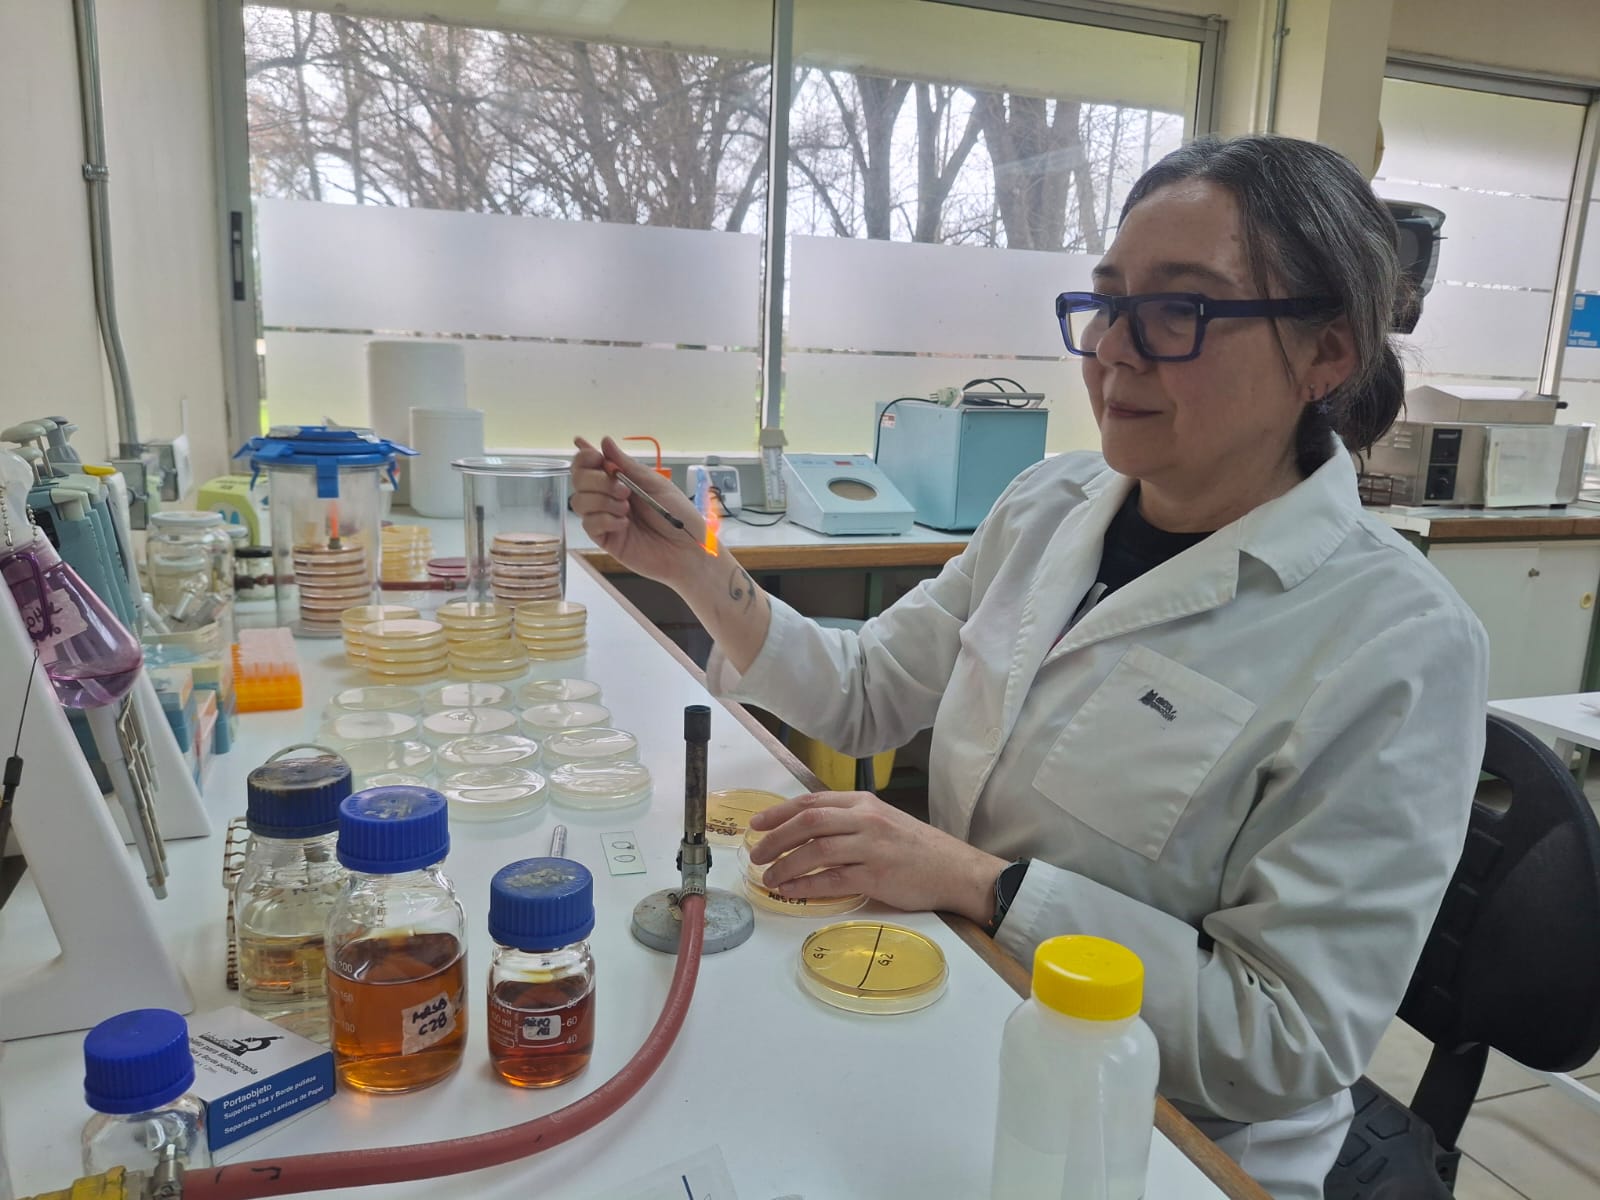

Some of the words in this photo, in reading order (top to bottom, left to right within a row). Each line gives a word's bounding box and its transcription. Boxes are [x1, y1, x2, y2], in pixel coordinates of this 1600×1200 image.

[566, 1015, 578, 1027] 60
[223, 1083, 272, 1110] Portaobjeto
[224, 1101, 257, 1120] Superficie
[275, 1085, 294, 1098] Borde
[294, 1075, 317, 1090] pulidos
[224, 1114, 259, 1135] Separados
[260, 1110, 272, 1119] con
[307, 1085, 324, 1097] Papel
